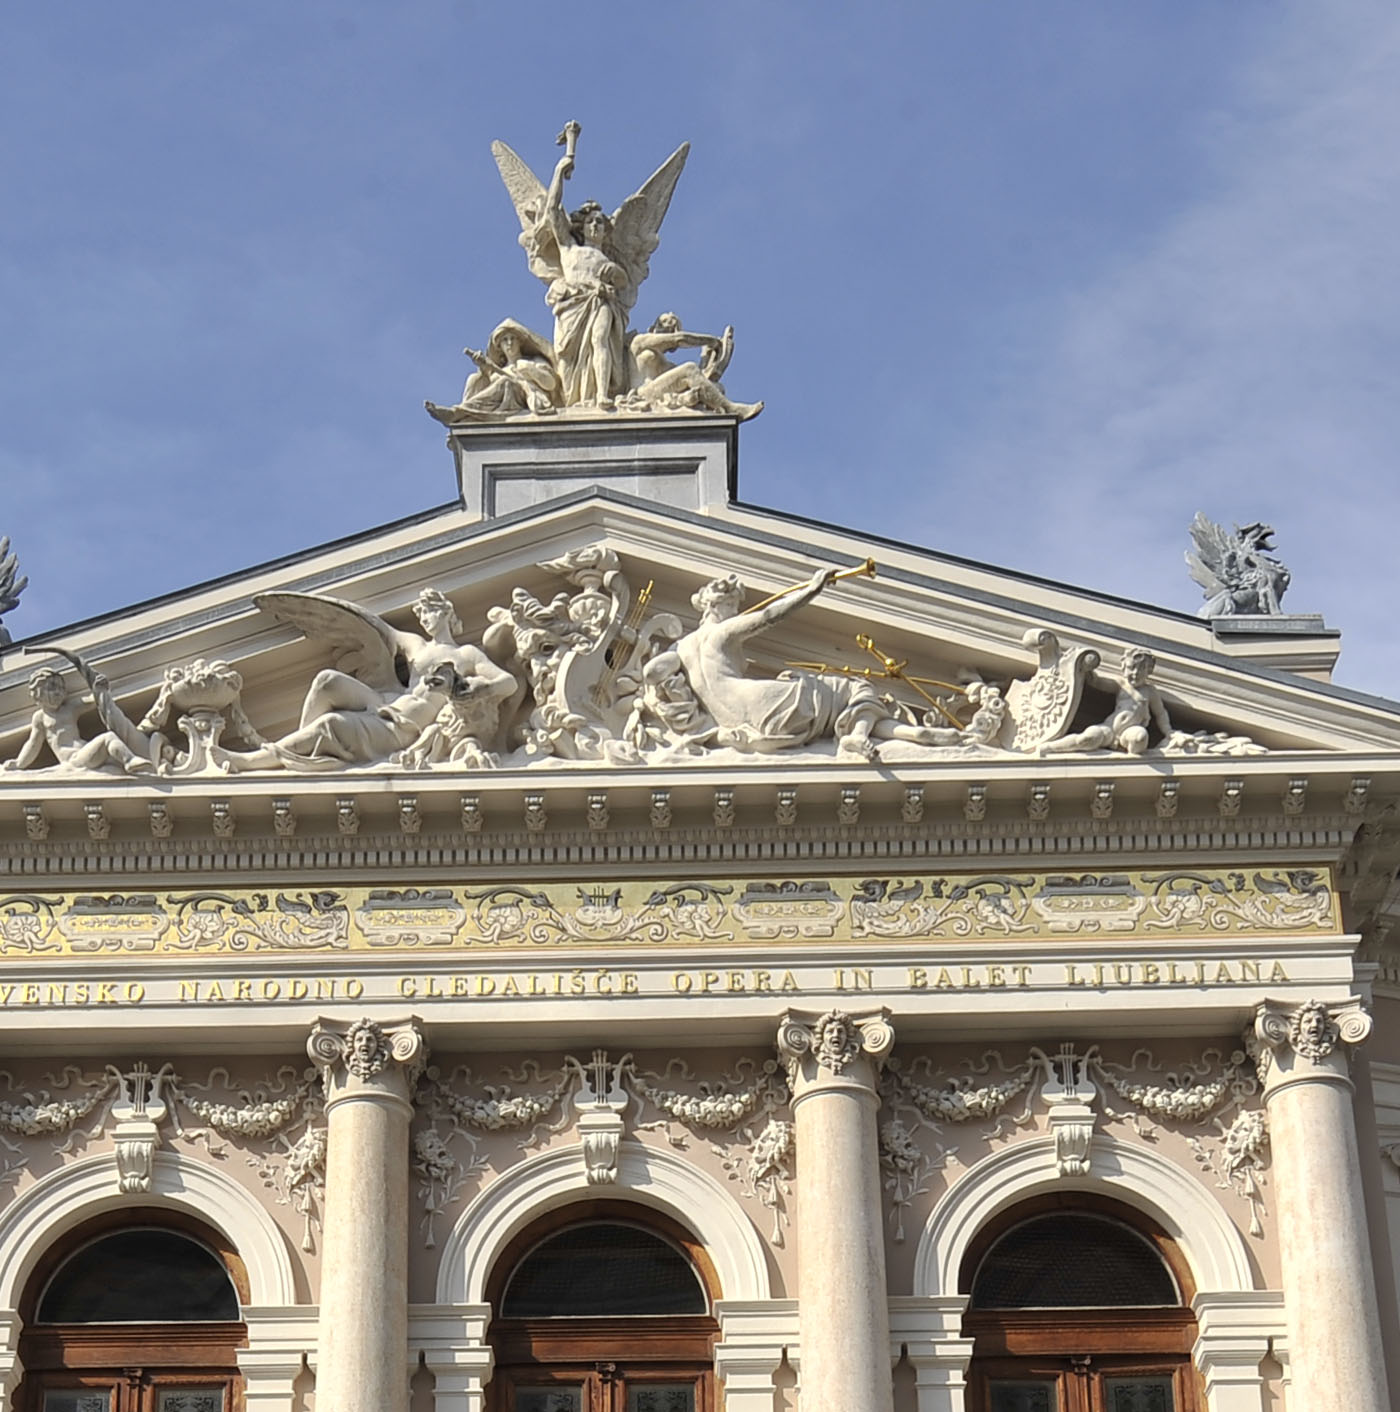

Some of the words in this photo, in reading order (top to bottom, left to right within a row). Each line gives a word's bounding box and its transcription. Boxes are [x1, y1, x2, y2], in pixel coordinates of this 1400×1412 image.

[178, 976, 365, 1002] NARODNO
[396, 968, 640, 998] GLEDALIŠČE
[671, 967, 801, 994] OPERA
[833, 967, 874, 992] IN
[907, 964, 1033, 990] BALET
[1064, 959, 1291, 988] LJUBLJANA
